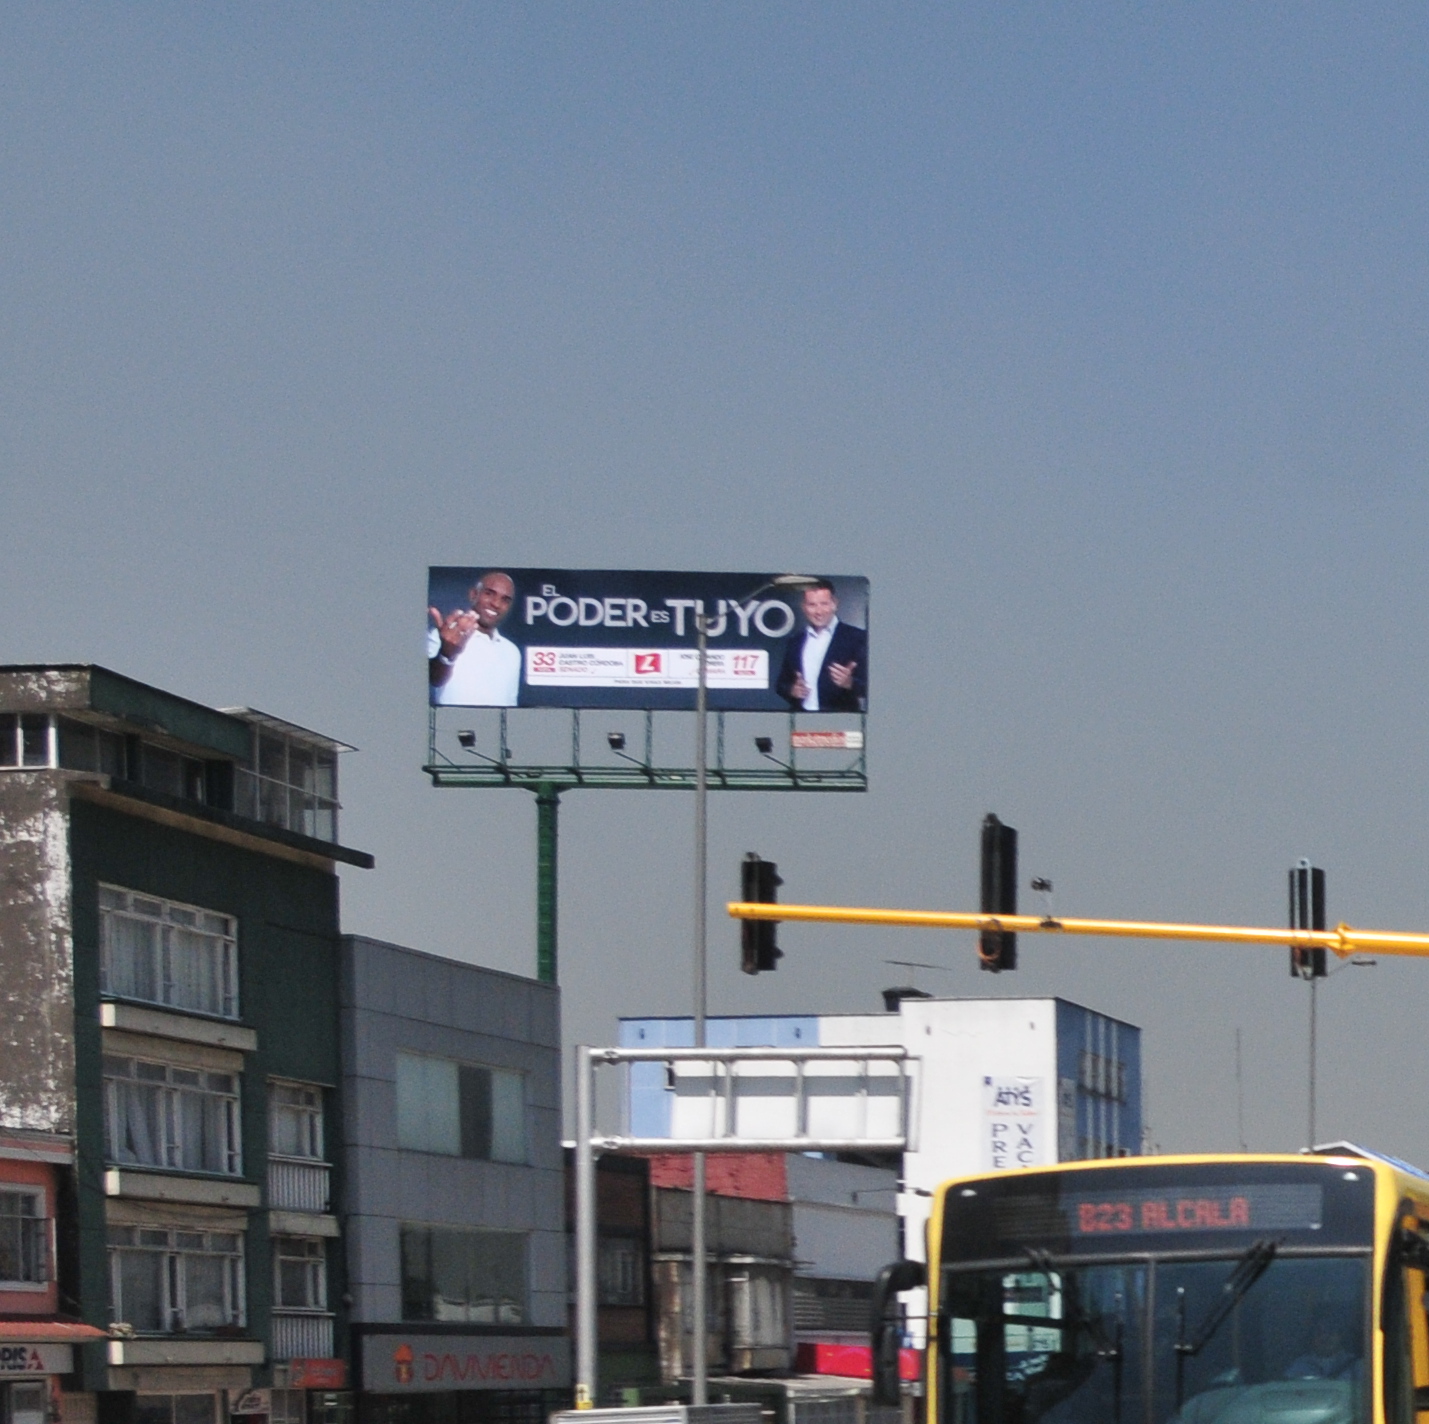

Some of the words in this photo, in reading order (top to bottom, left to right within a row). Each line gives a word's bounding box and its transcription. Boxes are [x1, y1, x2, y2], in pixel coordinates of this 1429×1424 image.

[542, 584, 560, 597] EL
[526, 596, 649, 627] PODER
[651, 610, 670, 623] ES
[665, 599, 795, 638] TUYO
[533, 652, 556, 666] 33
[733, 655, 759, 669] 117
